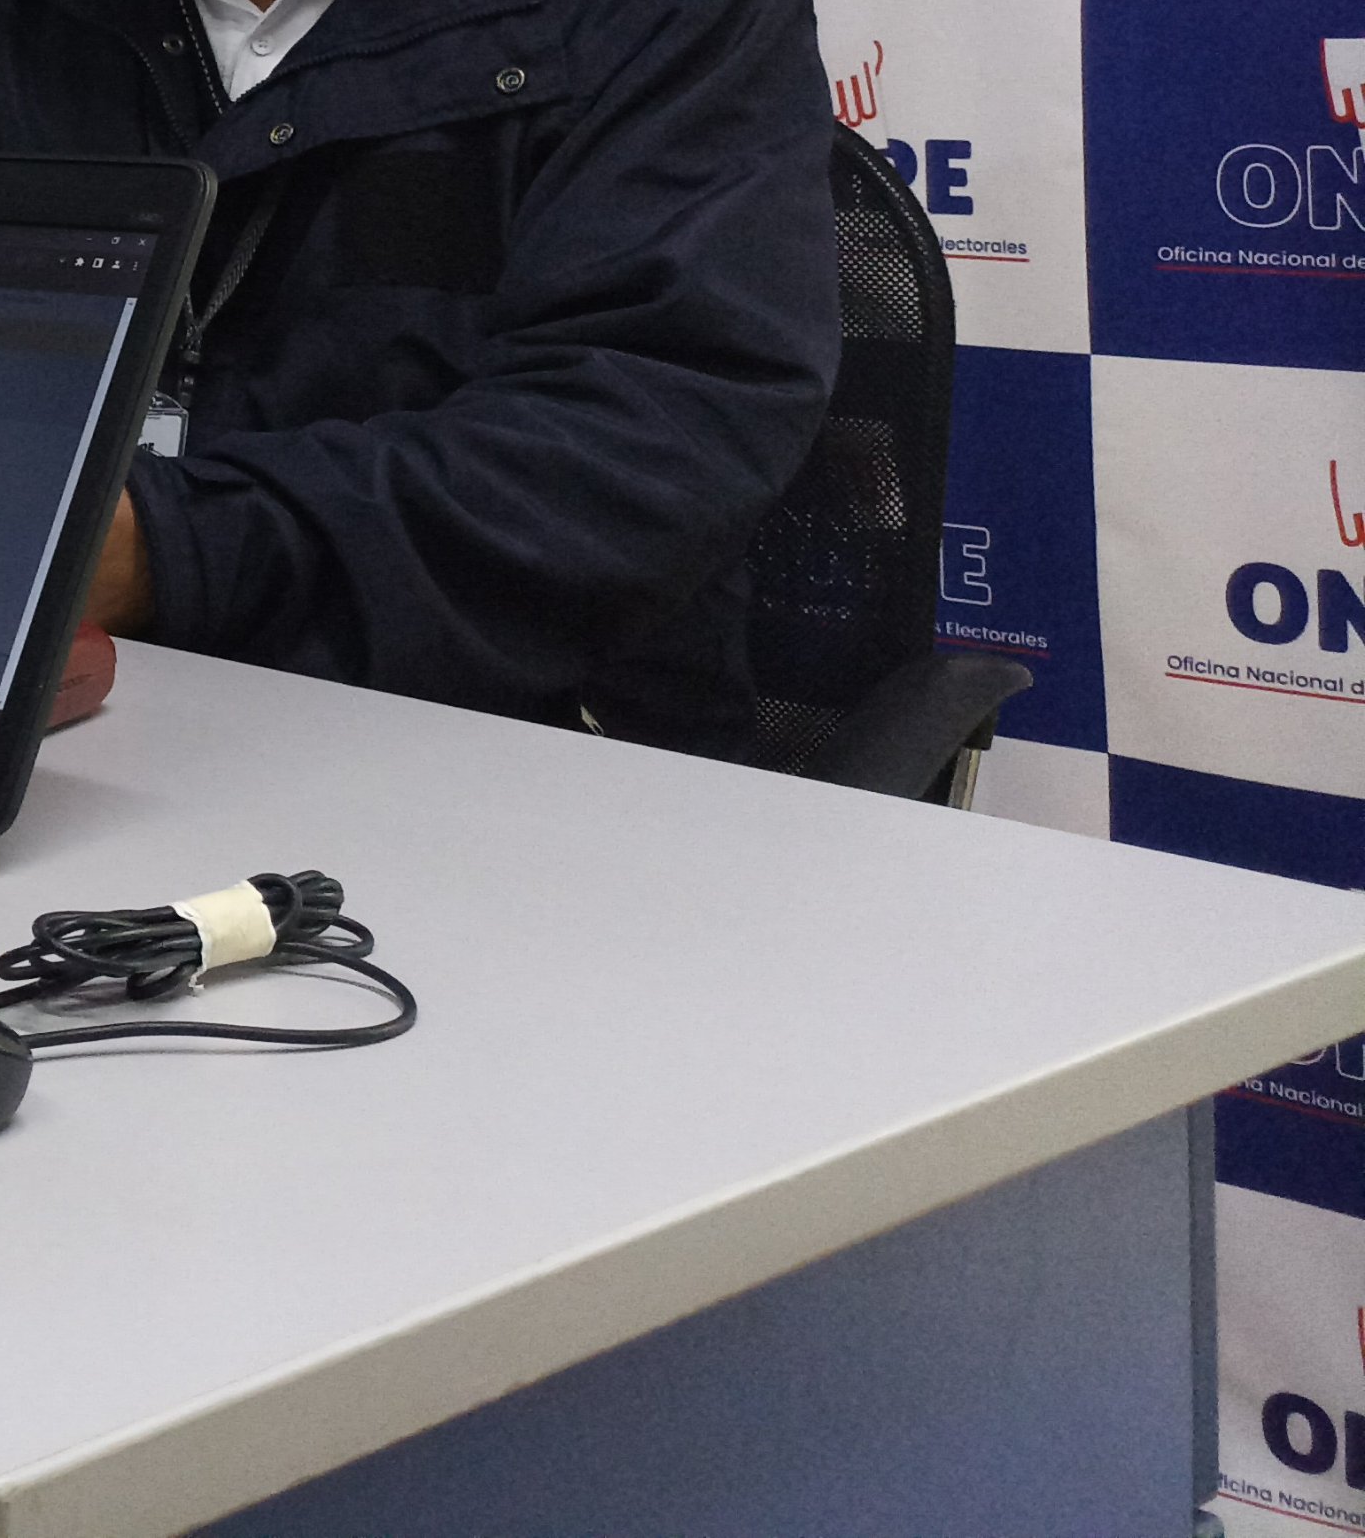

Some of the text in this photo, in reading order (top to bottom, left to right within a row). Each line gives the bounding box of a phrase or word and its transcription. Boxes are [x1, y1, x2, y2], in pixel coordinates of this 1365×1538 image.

[940, 237, 1029, 255] lectorales
[1157, 245, 1232, 265] Oficina
[1238, 249, 1336, 269] Nacional
[945, 621, 1049, 650] Electorales
[1167, 655, 1240, 679] Oficina
[1246, 665, 1345, 694] Nacional
